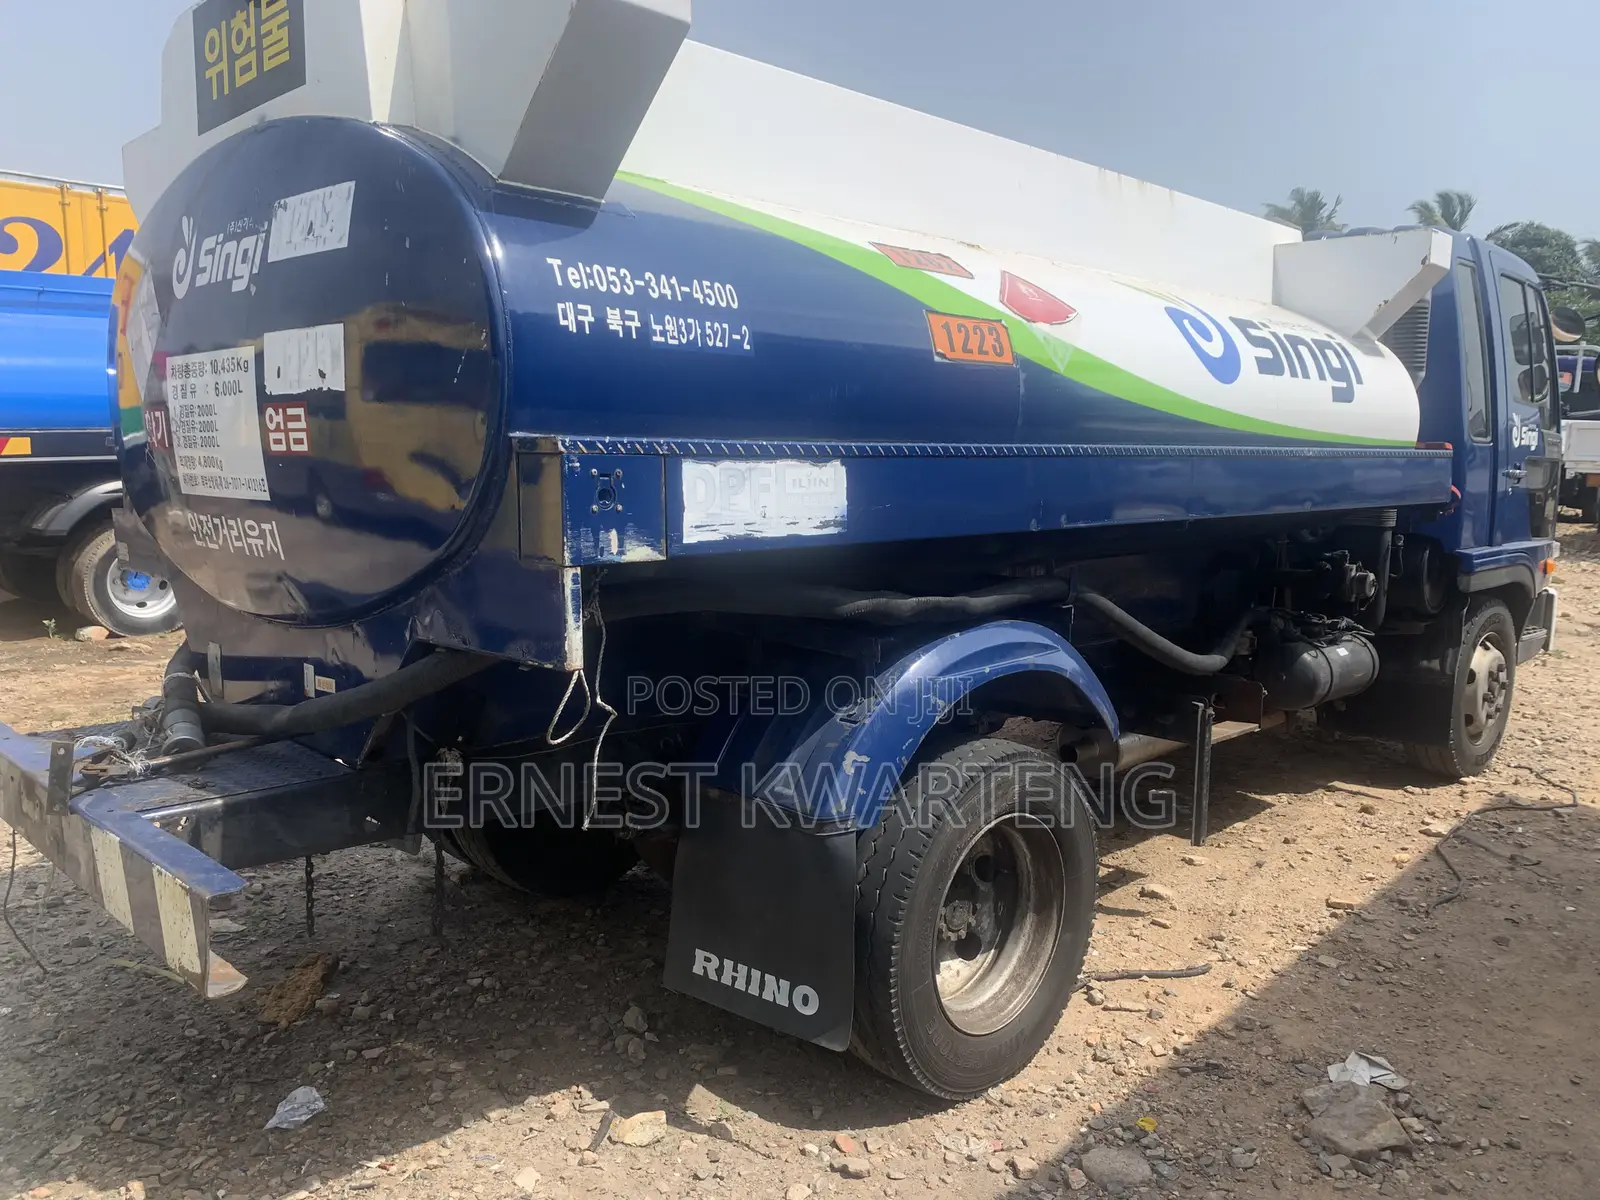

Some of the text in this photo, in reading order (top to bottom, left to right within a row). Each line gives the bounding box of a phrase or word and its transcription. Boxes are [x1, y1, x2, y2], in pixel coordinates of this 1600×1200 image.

[205, 0, 289, 100] 위험물
[557, 302, 595, 334] 대구
[606, 307, 641, 339] 북구
[705, 320, 751, 350] 527-2
[940, 320, 1005, 357] 1223
[1228, 316, 1364, 403] Singi
[265, 407, 308, 452] 엄금
[187, 512, 286, 560] 안전거리유지
[692, 948, 820, 1016] RHINO
